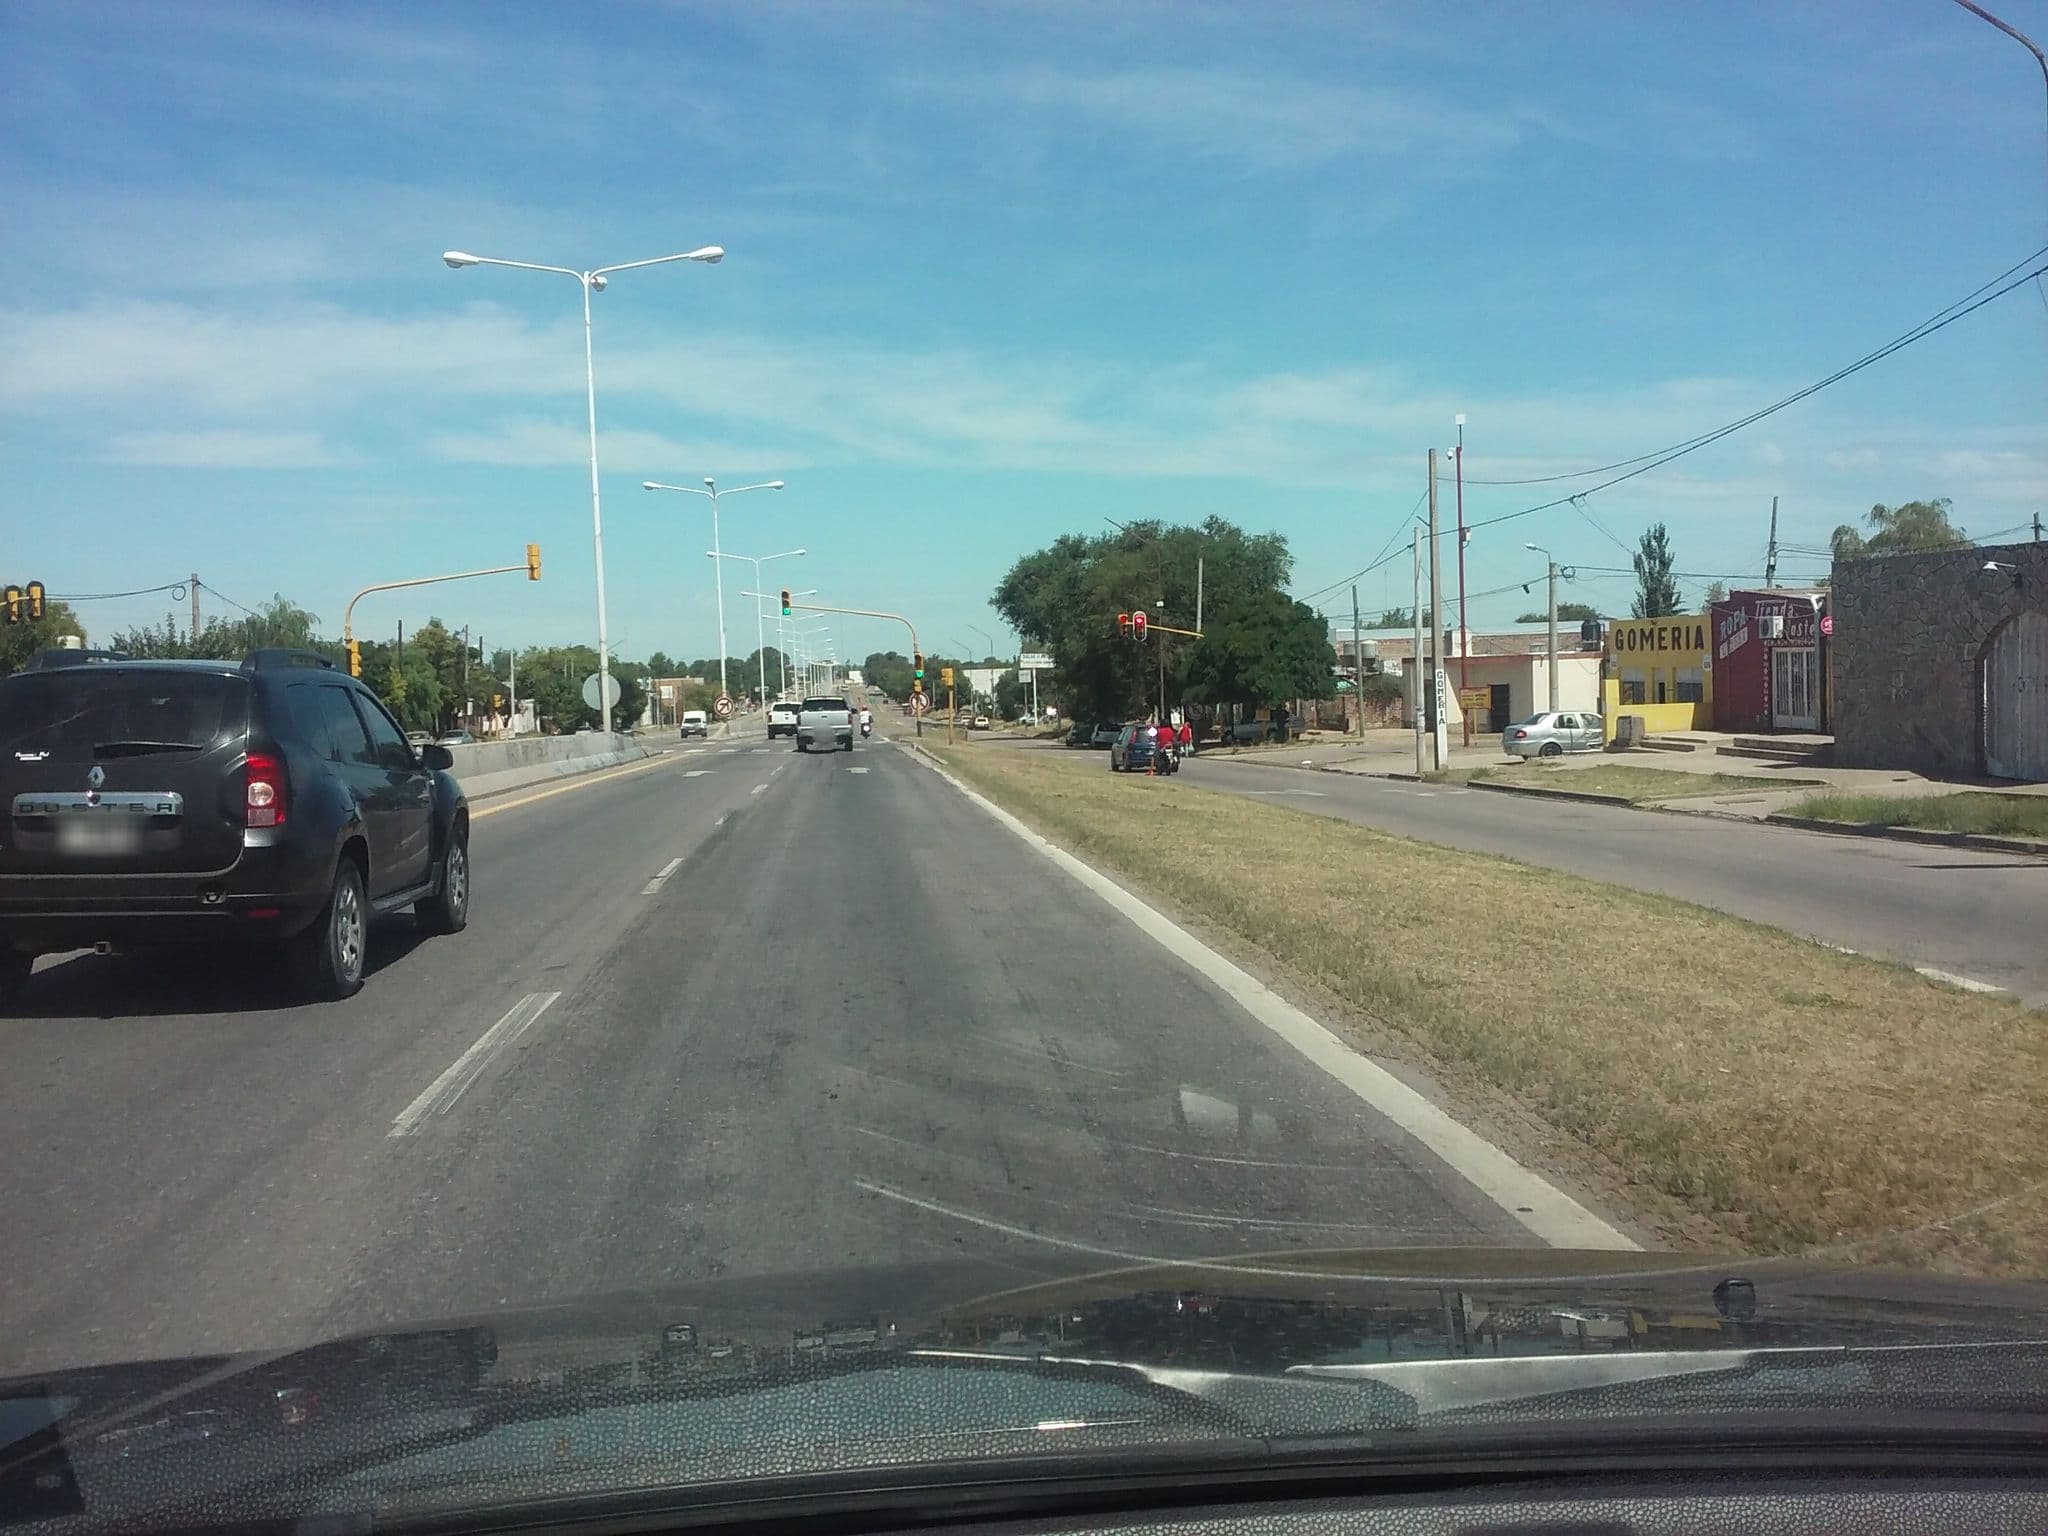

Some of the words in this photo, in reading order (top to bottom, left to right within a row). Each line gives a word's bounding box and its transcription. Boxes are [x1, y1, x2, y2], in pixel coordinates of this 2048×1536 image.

[1615, 624, 1704, 651] GOMERIA
[1720, 606, 1746, 640] ROPA
[1437, 671, 1445, 725] GOMERIA
[19, 802, 172, 813] DUSTER
